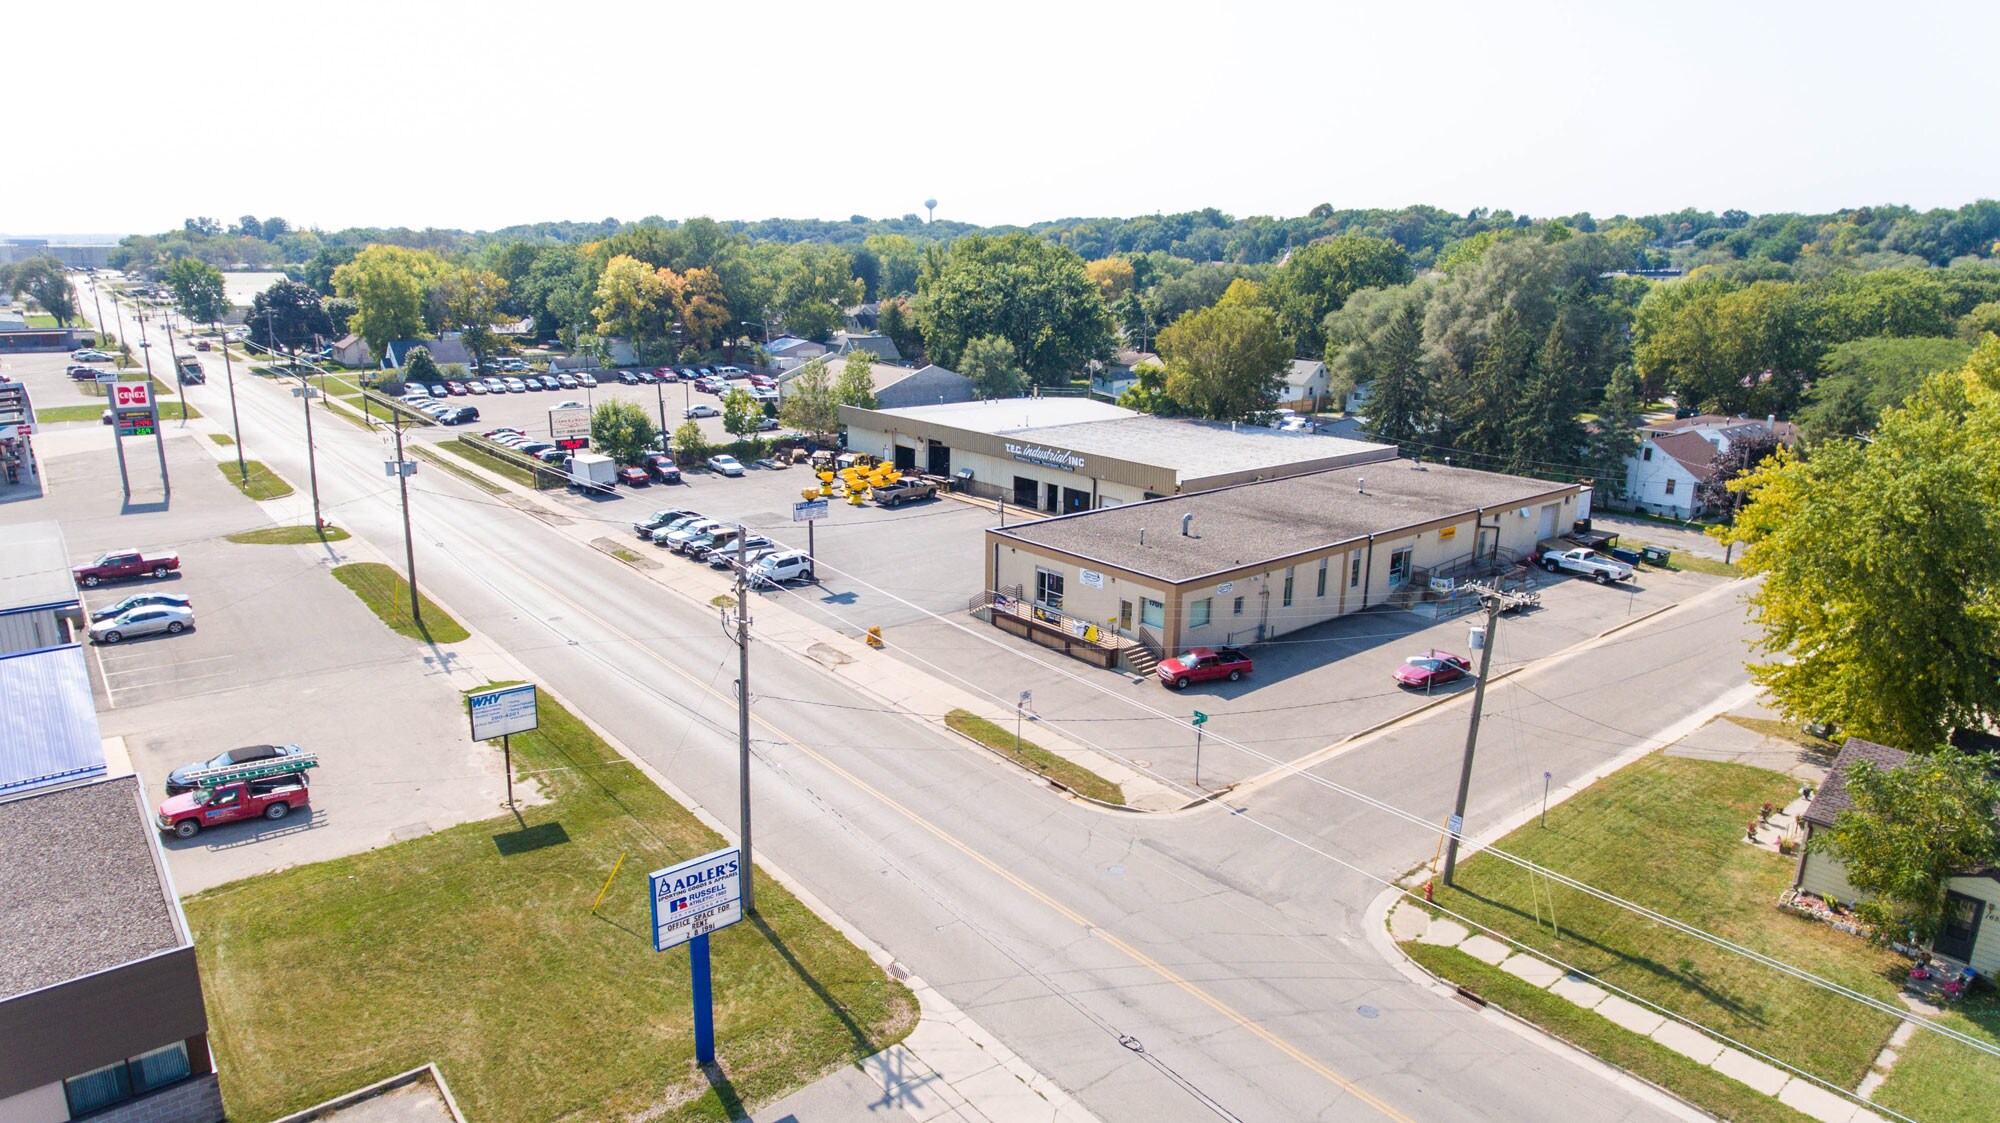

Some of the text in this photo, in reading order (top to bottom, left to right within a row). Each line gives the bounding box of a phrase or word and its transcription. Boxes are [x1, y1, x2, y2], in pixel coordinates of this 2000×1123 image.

[119, 391, 145, 399] CENEX
[1023, 444, 1071, 463] industrial
[1068, 456, 1084, 467] INC
[471, 693, 501, 708] WHV
[673, 860, 738, 892] ADLER'S
[658, 889, 687, 902] SPORTING
[688, 882, 707, 892] GOODS
[714, 872, 738, 883] APPAREL
[689, 884, 727, 901] RUSSELL
[689, 895, 714, 907] ATHLETIC
[667, 904, 730, 932] OFFICE SPACE FOR
[691, 919, 708, 930] RENT
